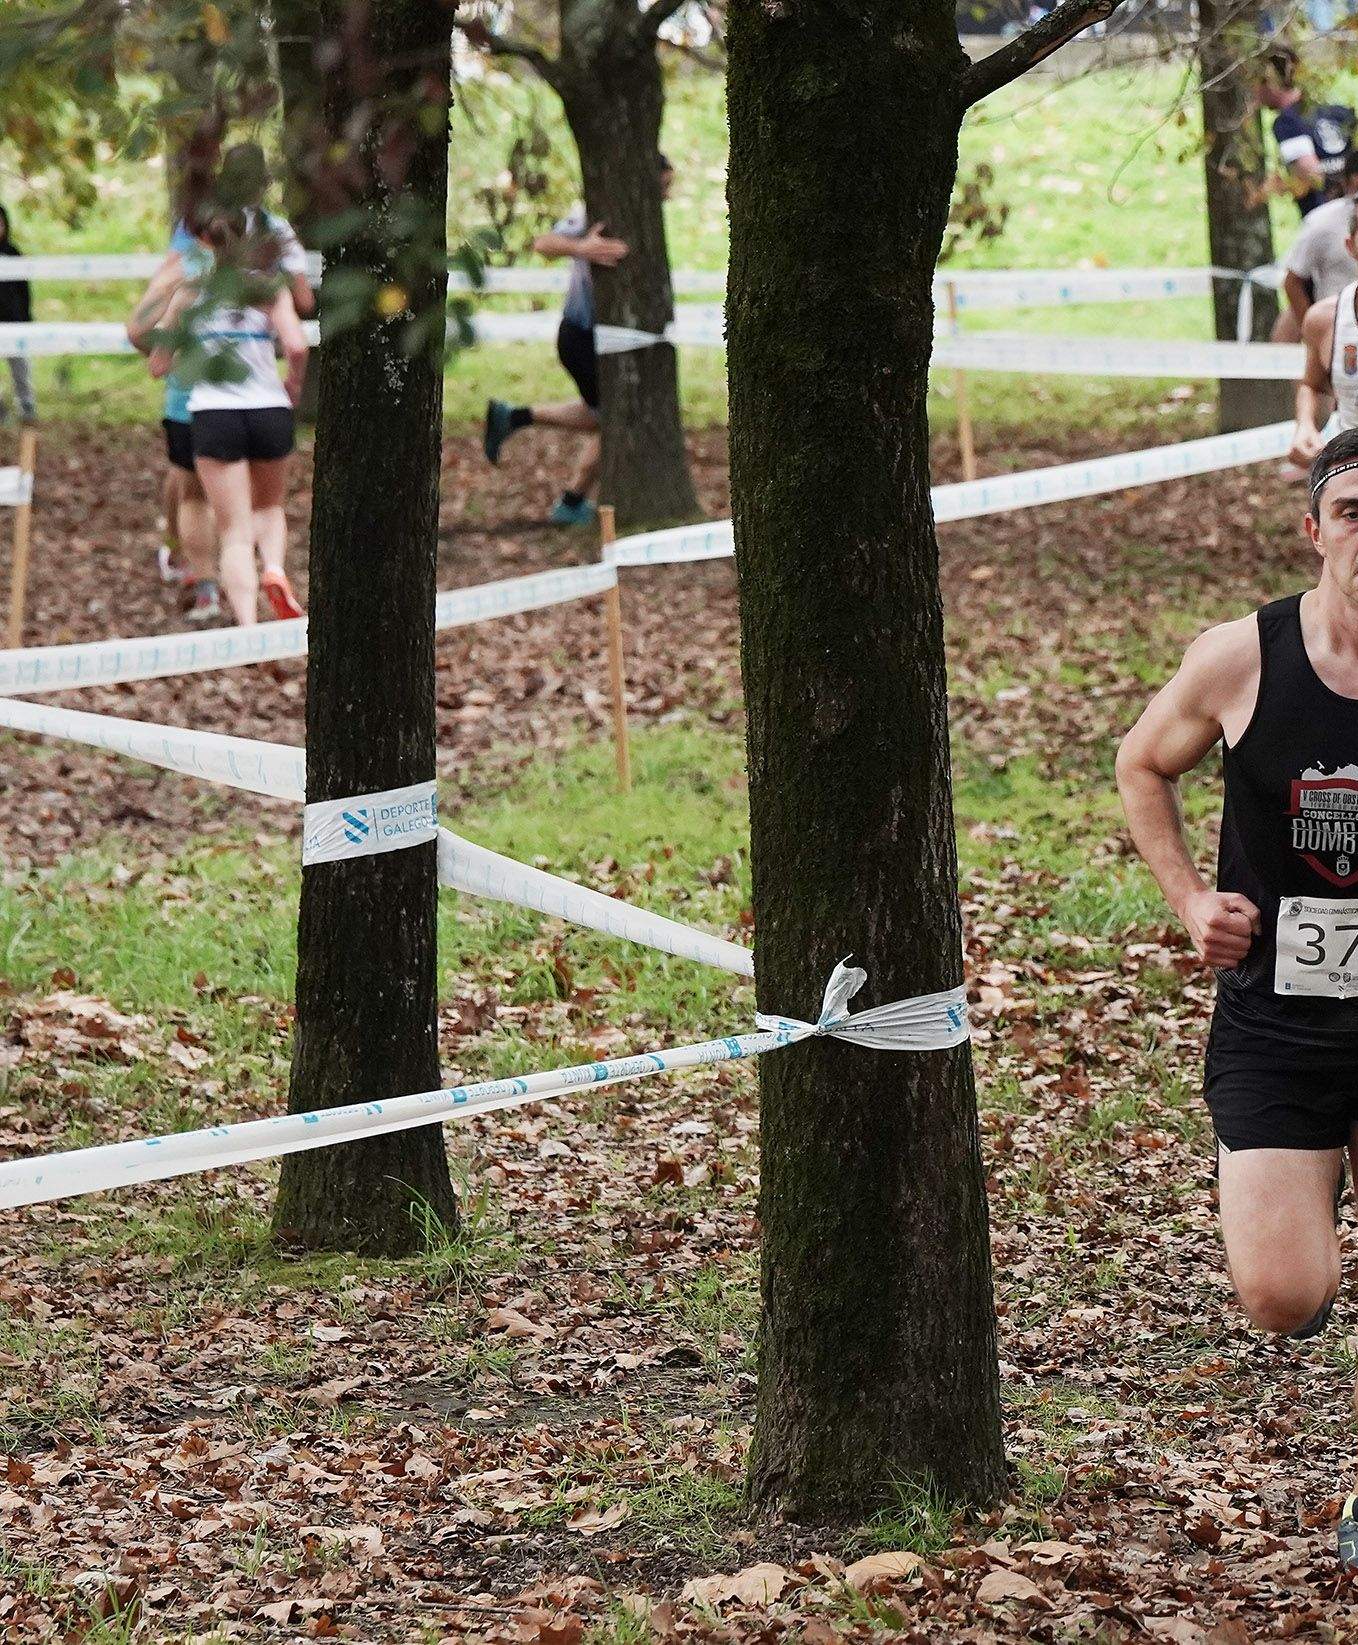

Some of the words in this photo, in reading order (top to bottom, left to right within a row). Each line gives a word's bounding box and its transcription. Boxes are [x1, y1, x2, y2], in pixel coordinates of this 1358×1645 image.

[1309, 791, 1332, 802] CROSS
[381, 799, 430, 820] DEPORTE
[383, 816, 429, 837] GALEGO
